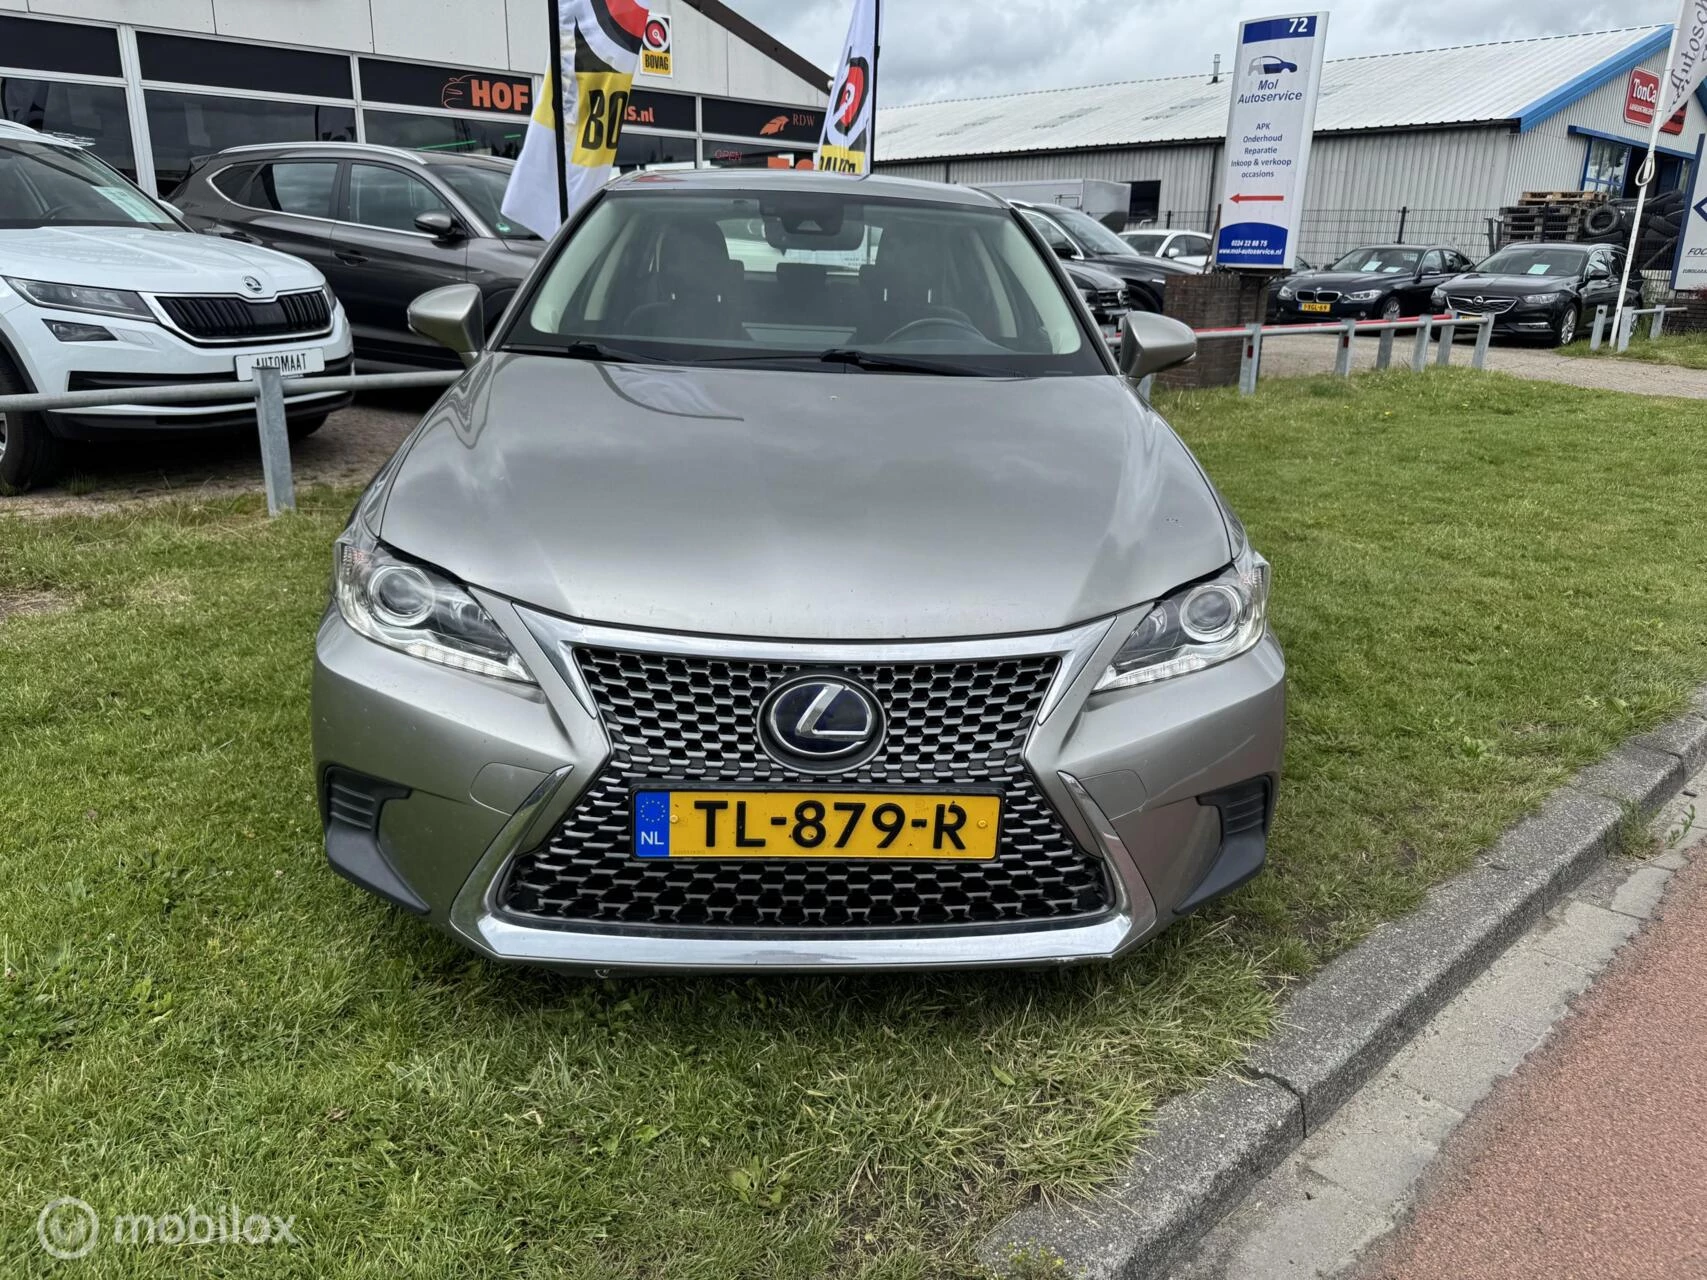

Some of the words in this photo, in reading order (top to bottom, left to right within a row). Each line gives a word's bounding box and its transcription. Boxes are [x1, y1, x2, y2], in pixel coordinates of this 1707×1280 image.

[1288, 17, 1309, 34] 72
[644, 54, 669, 70] BOVAG
[1257, 79, 1279, 91] Mol
[471, 79, 529, 111] HOF
[1237, 90, 1303, 105] Autoservice
[792, 113, 815, 128] RDW
[1255, 122, 1271, 131] APK
[1242, 134, 1283, 143] Onderhoud
[1244, 146, 1278, 156] Reparatie
[1230, 160, 1252, 168] Inkoop
[1253, 158, 1259, 166] &
[1260, 158, 1292, 168] verkoop
[1241, 170, 1274, 178] occasions
[693, 799, 968, 851] TL-879-R
[640, 831, 665, 846] NL
